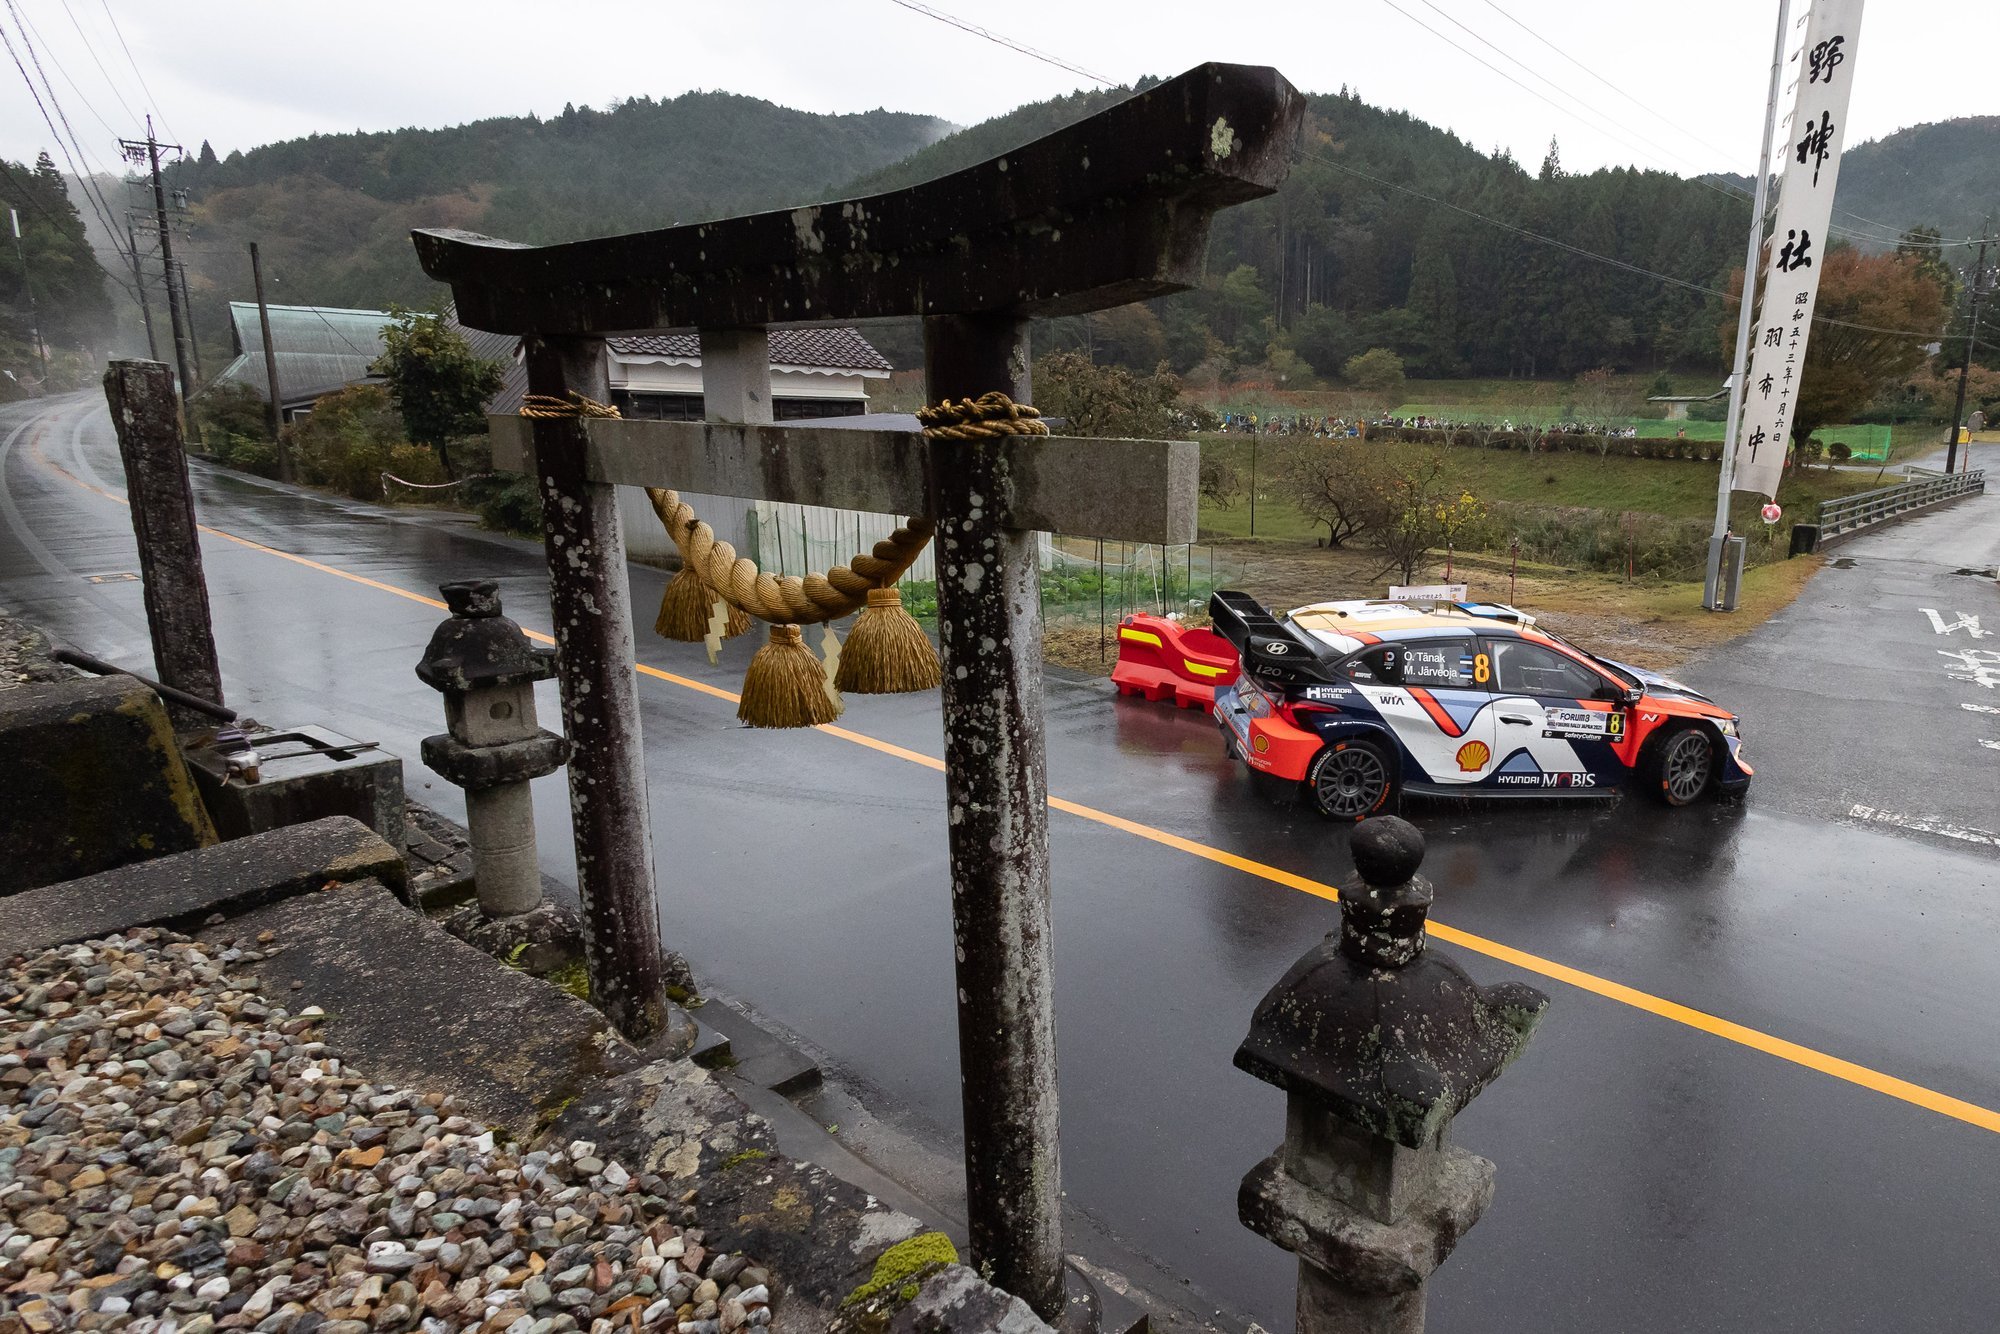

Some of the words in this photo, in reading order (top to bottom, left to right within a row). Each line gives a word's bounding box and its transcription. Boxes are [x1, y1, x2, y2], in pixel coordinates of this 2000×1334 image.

[1772, 291, 1808, 443] 昭和五十三年十月六日
[1403, 652, 1415, 663] O.
[1416, 651, 1446, 663] Tänak
[1403, 664, 1416, 676] M.
[1417, 665, 1458, 679] Järveoja
[1474, 653, 1490, 683] 8
[1321, 687, 1353, 695] HYUNDAI
[1610, 714, 1620, 734] 8
[1564, 732, 1602, 740] SafetyCulture
[1498, 775, 1540, 784] HYUNDAI
[1541, 772, 1596, 788] MOBIS
